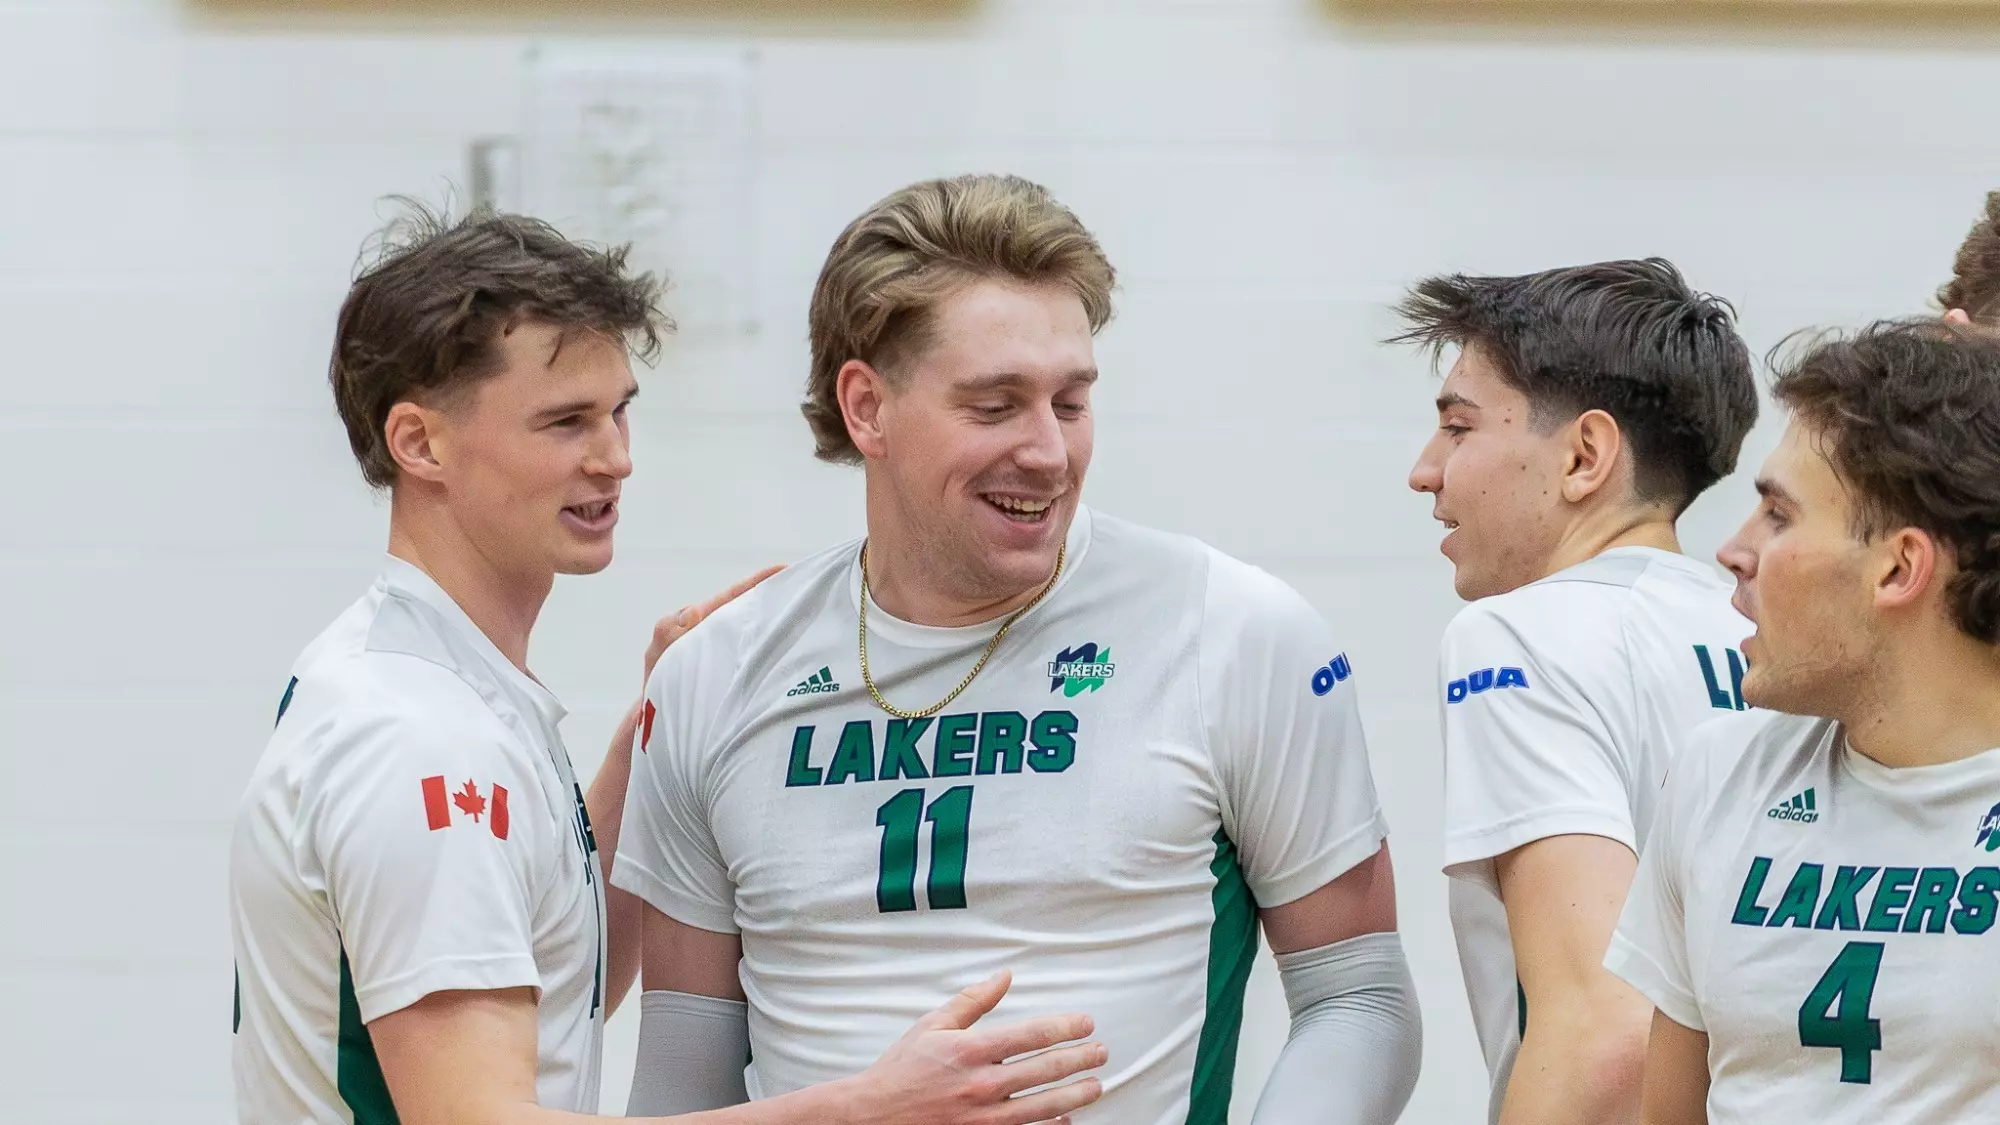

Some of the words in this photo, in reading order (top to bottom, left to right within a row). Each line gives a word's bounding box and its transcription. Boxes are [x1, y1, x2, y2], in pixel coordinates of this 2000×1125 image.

[787, 683, 840, 697] adidas
[1048, 661, 1115, 678] LAKERS
[1311, 652, 1352, 697] OU
[785, 711, 1079, 787] LAKERS
[876, 785, 974, 913] 11
[1731, 856, 2000, 935] LAKERS
[1798, 941, 1885, 1085] 4
